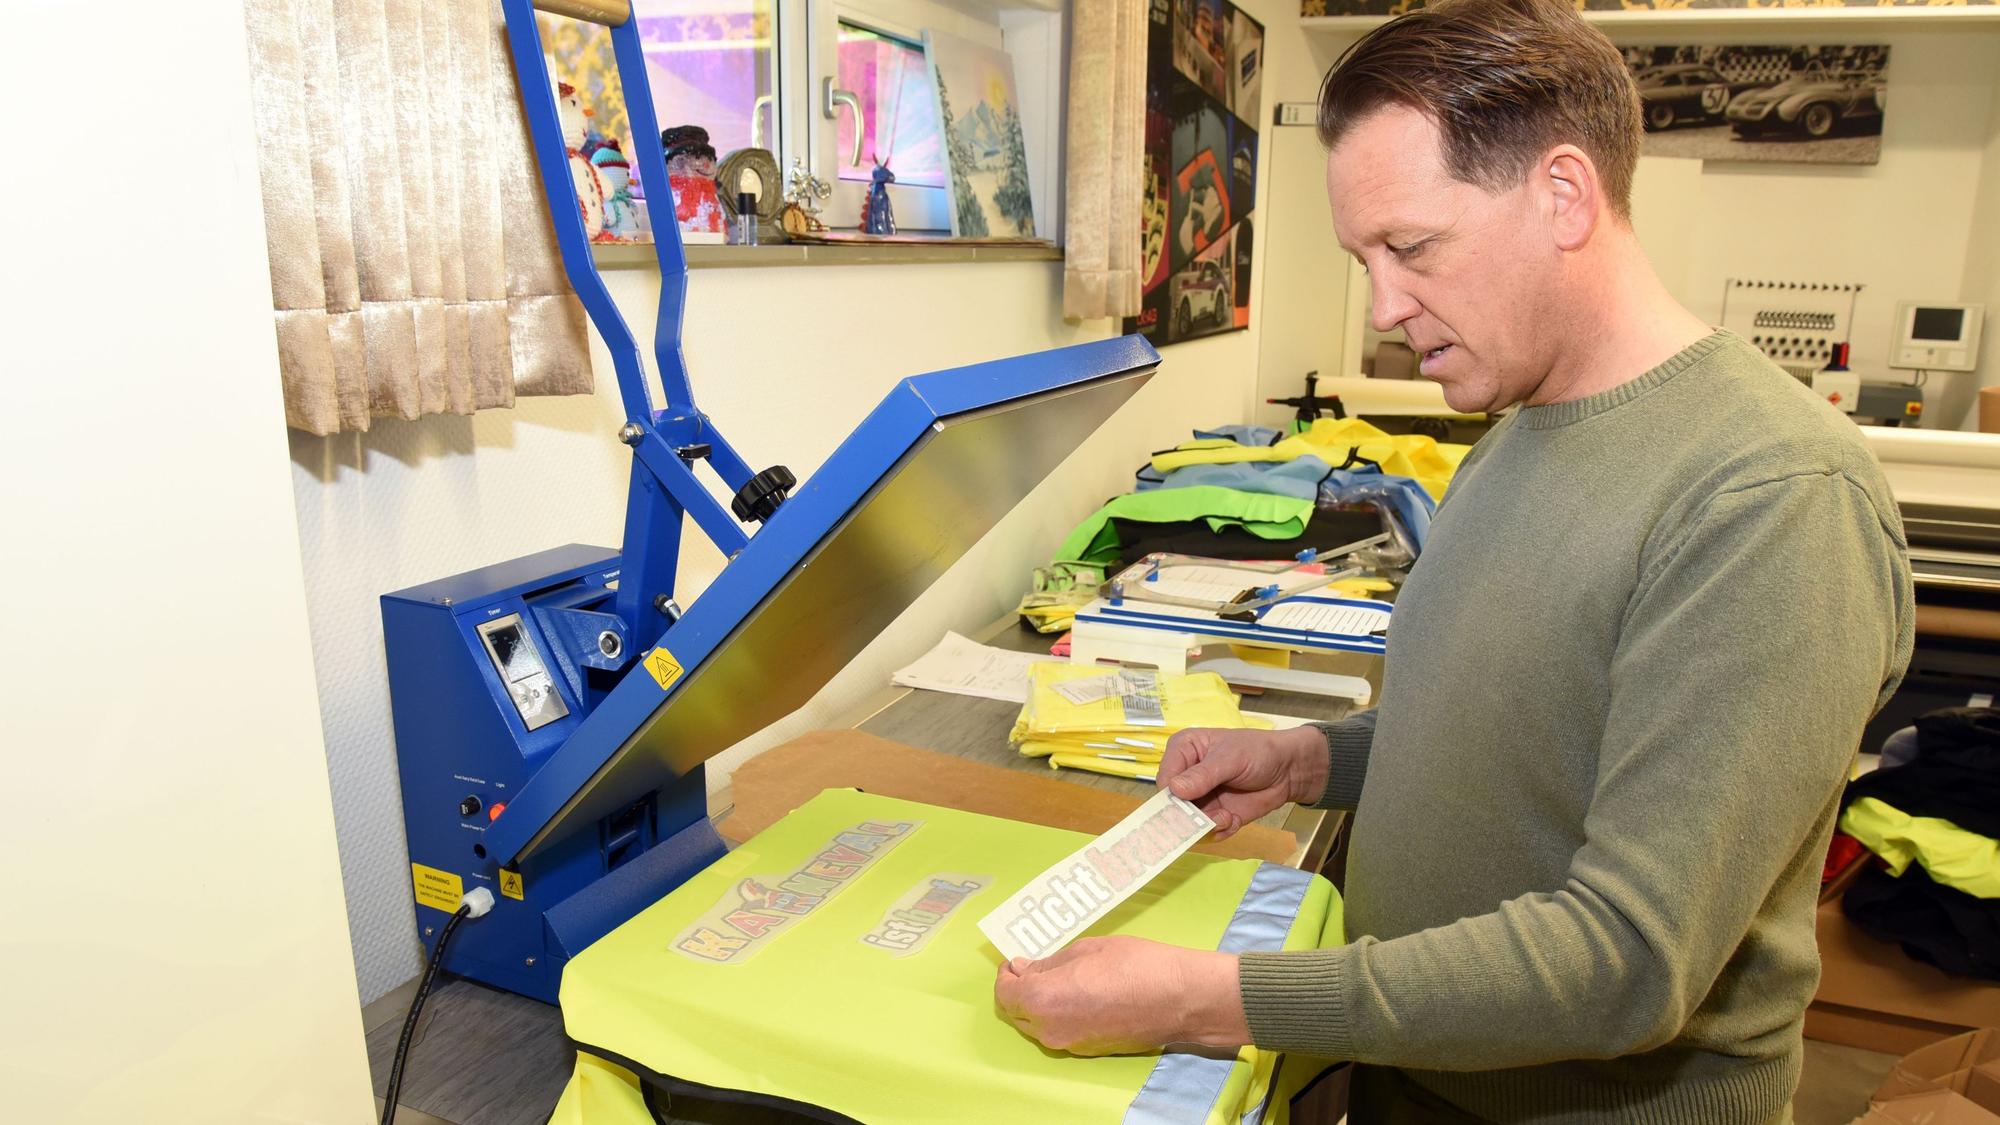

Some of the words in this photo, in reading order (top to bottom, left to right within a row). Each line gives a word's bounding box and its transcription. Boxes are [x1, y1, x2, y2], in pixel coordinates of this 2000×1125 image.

[424, 873, 450, 886] WARNING
[677, 822, 914, 962] KARNEVAL
[1005, 862, 1113, 957] nicht
[864, 919, 930, 950] ist
